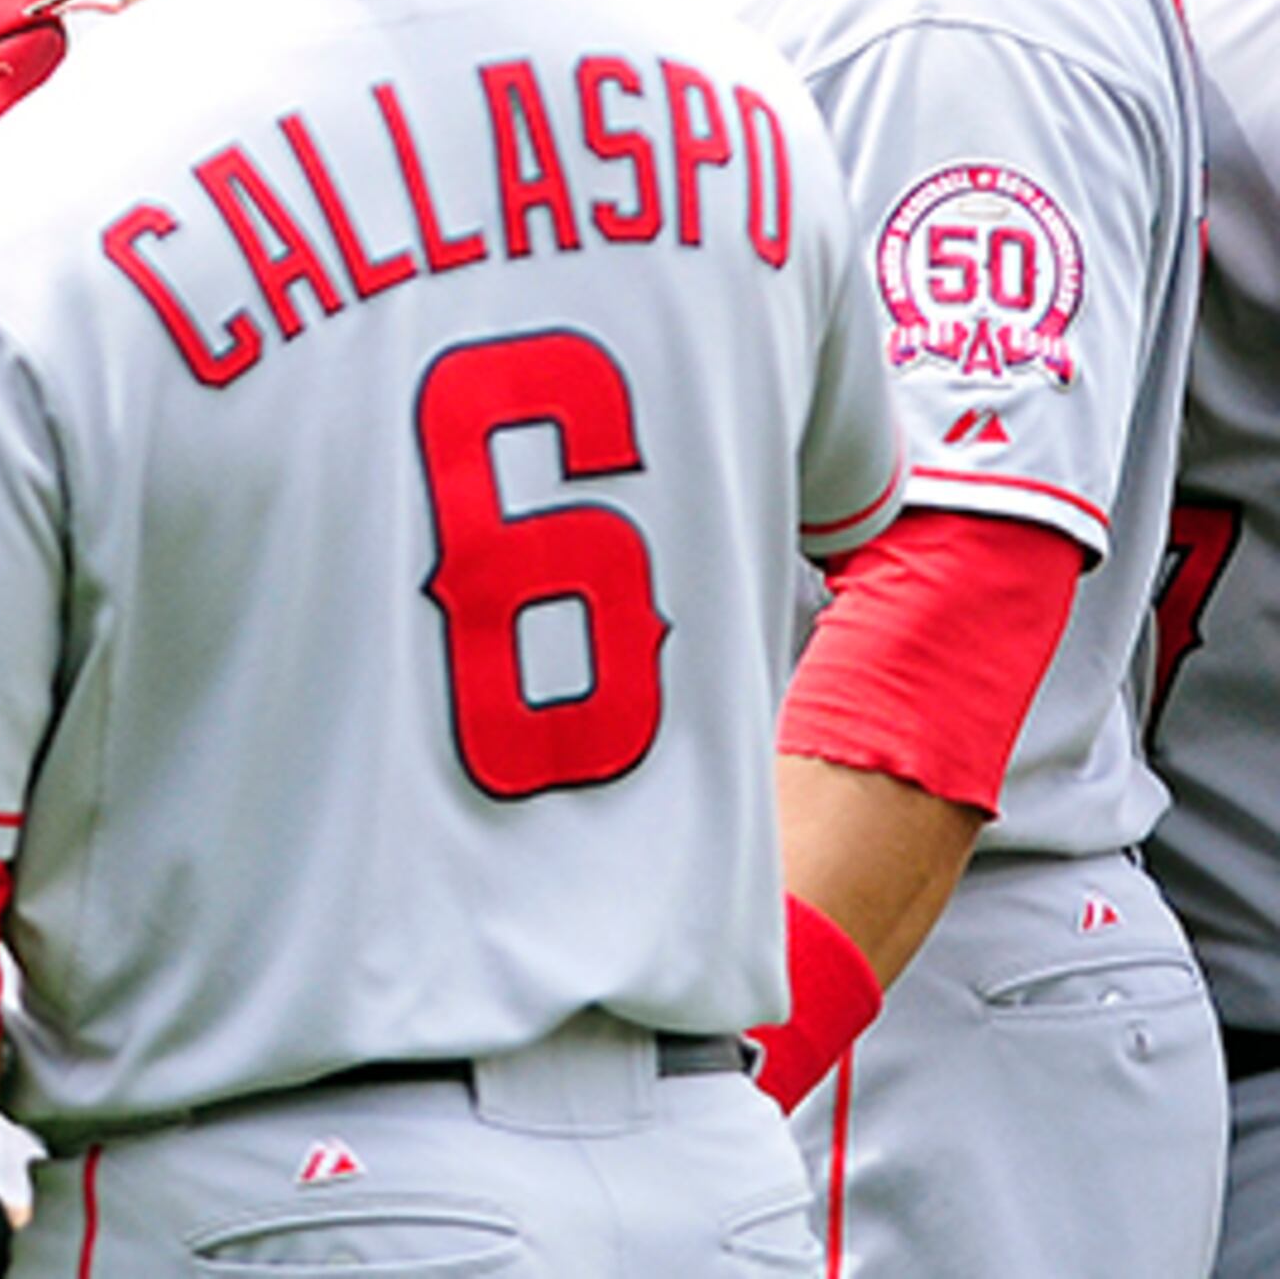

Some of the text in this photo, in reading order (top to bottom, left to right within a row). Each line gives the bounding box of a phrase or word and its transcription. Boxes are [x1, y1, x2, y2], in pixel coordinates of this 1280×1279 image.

[101, 54, 794, 390] CALLASPO
[926, 223, 1040, 312] 50
[413, 325, 671, 803] 6
